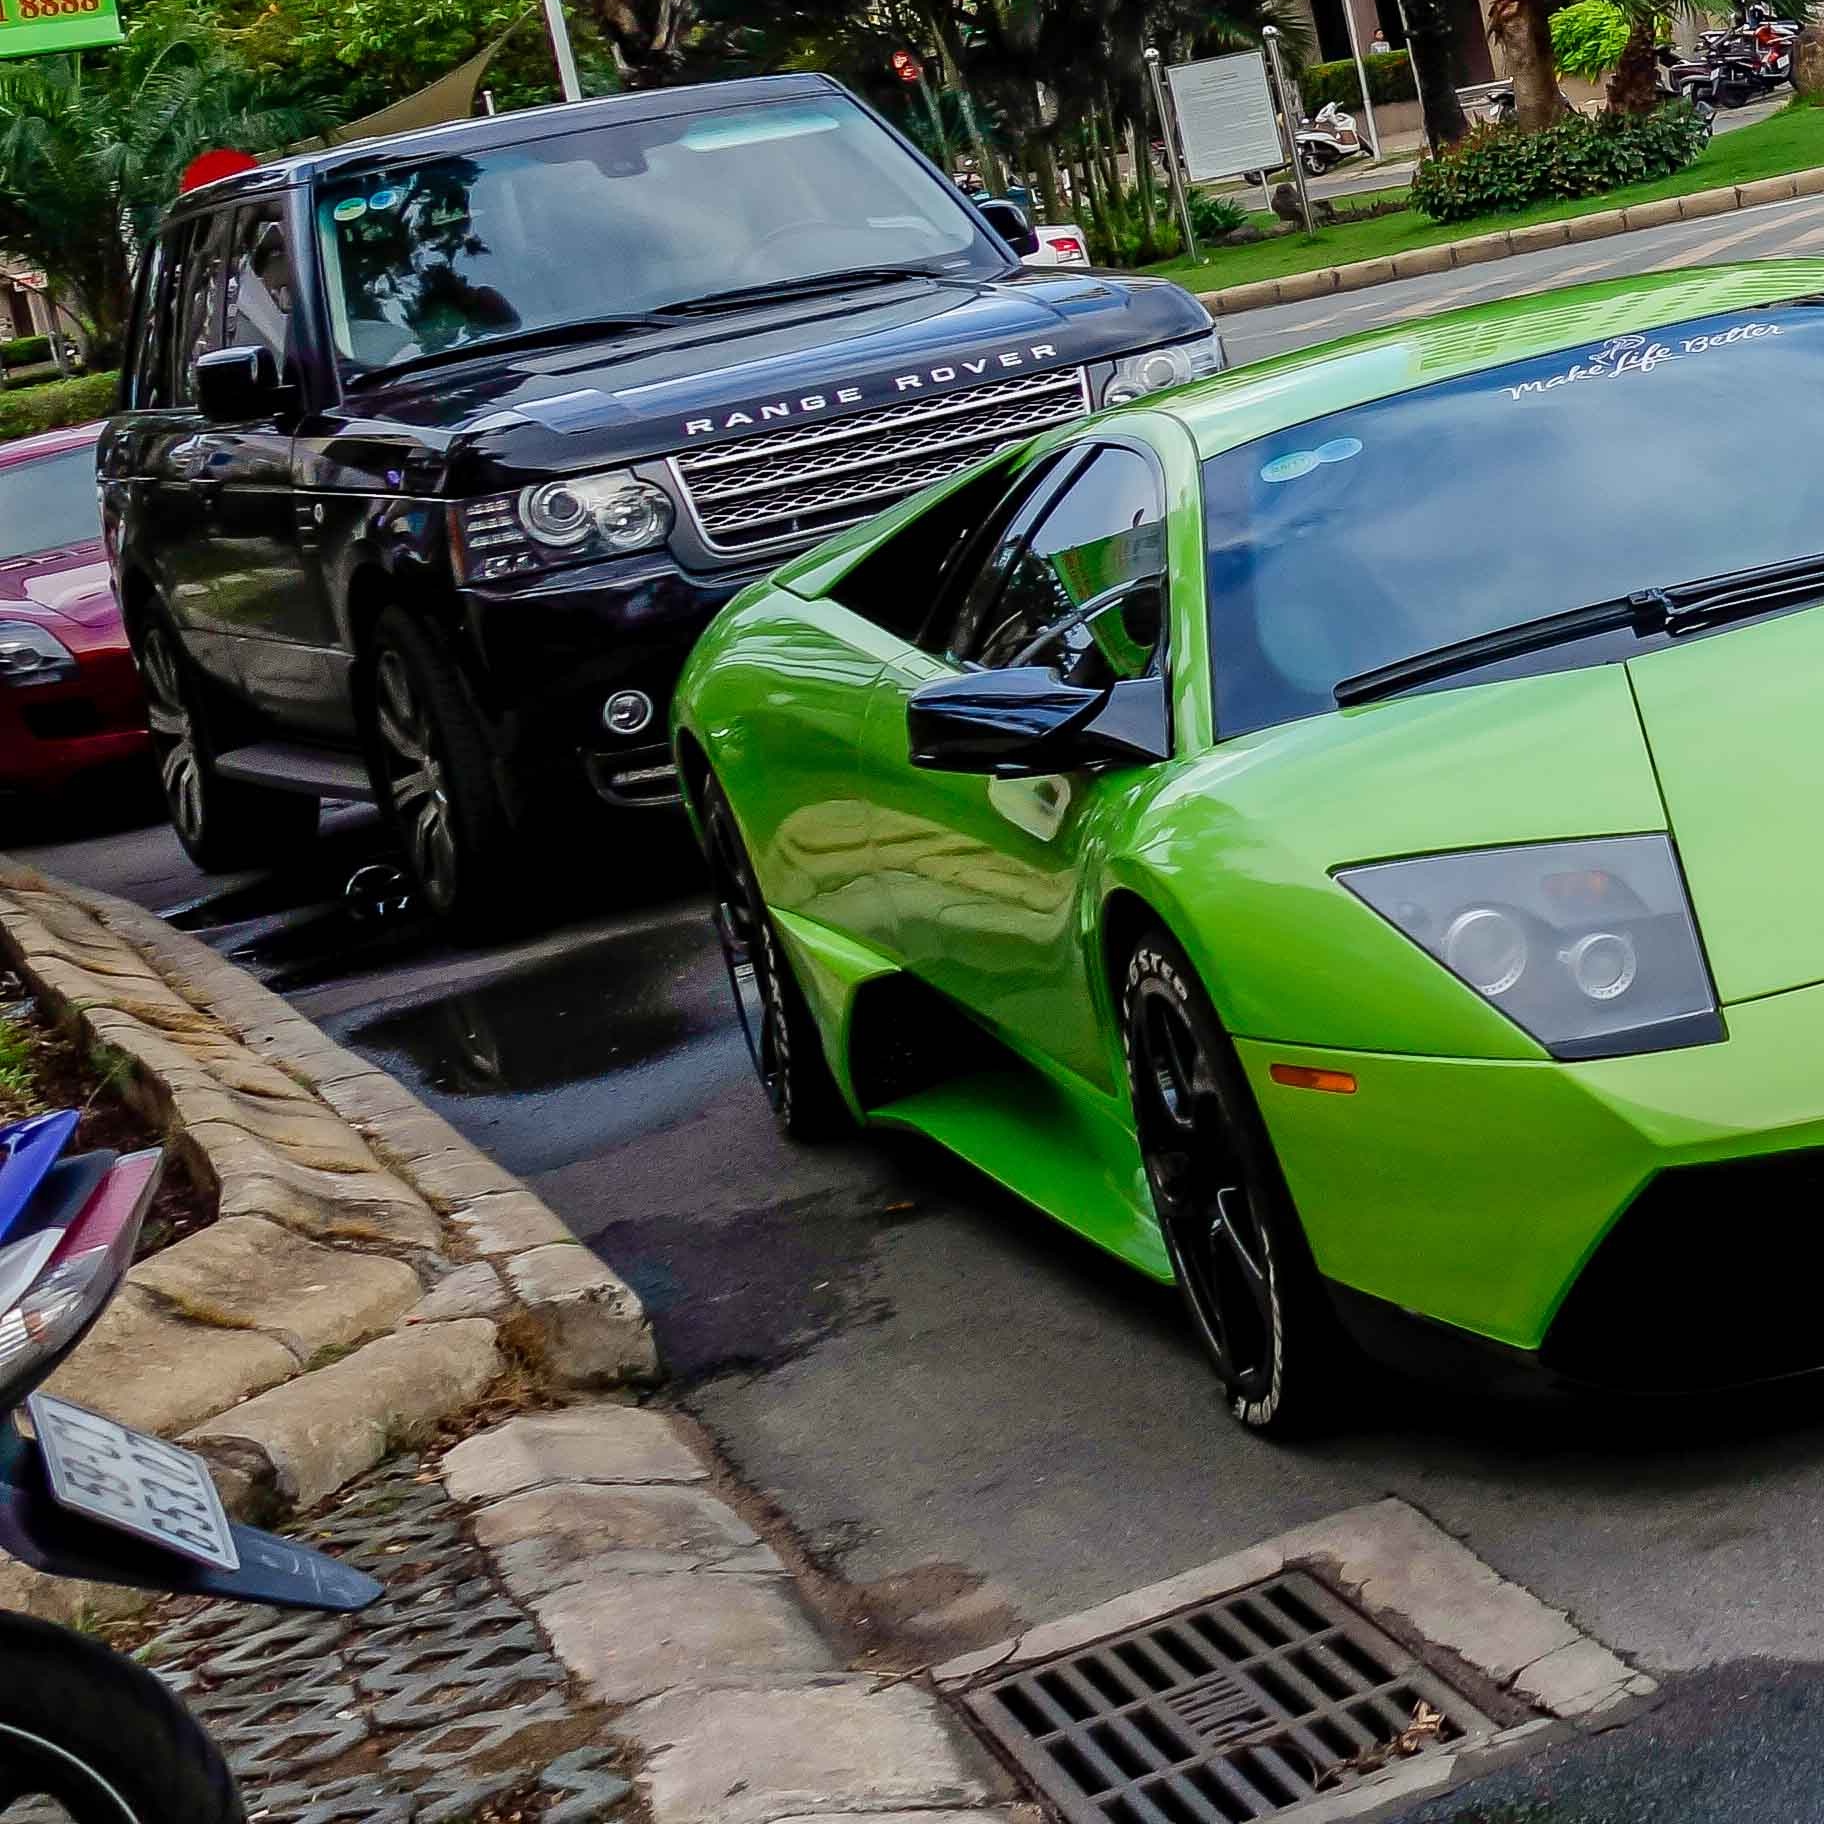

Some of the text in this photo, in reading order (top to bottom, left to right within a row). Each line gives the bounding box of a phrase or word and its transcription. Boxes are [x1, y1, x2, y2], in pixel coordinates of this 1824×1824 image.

[685, 344, 1057, 435] RANGE ROVER
[1499, 321, 1785, 401] Make Life Better
